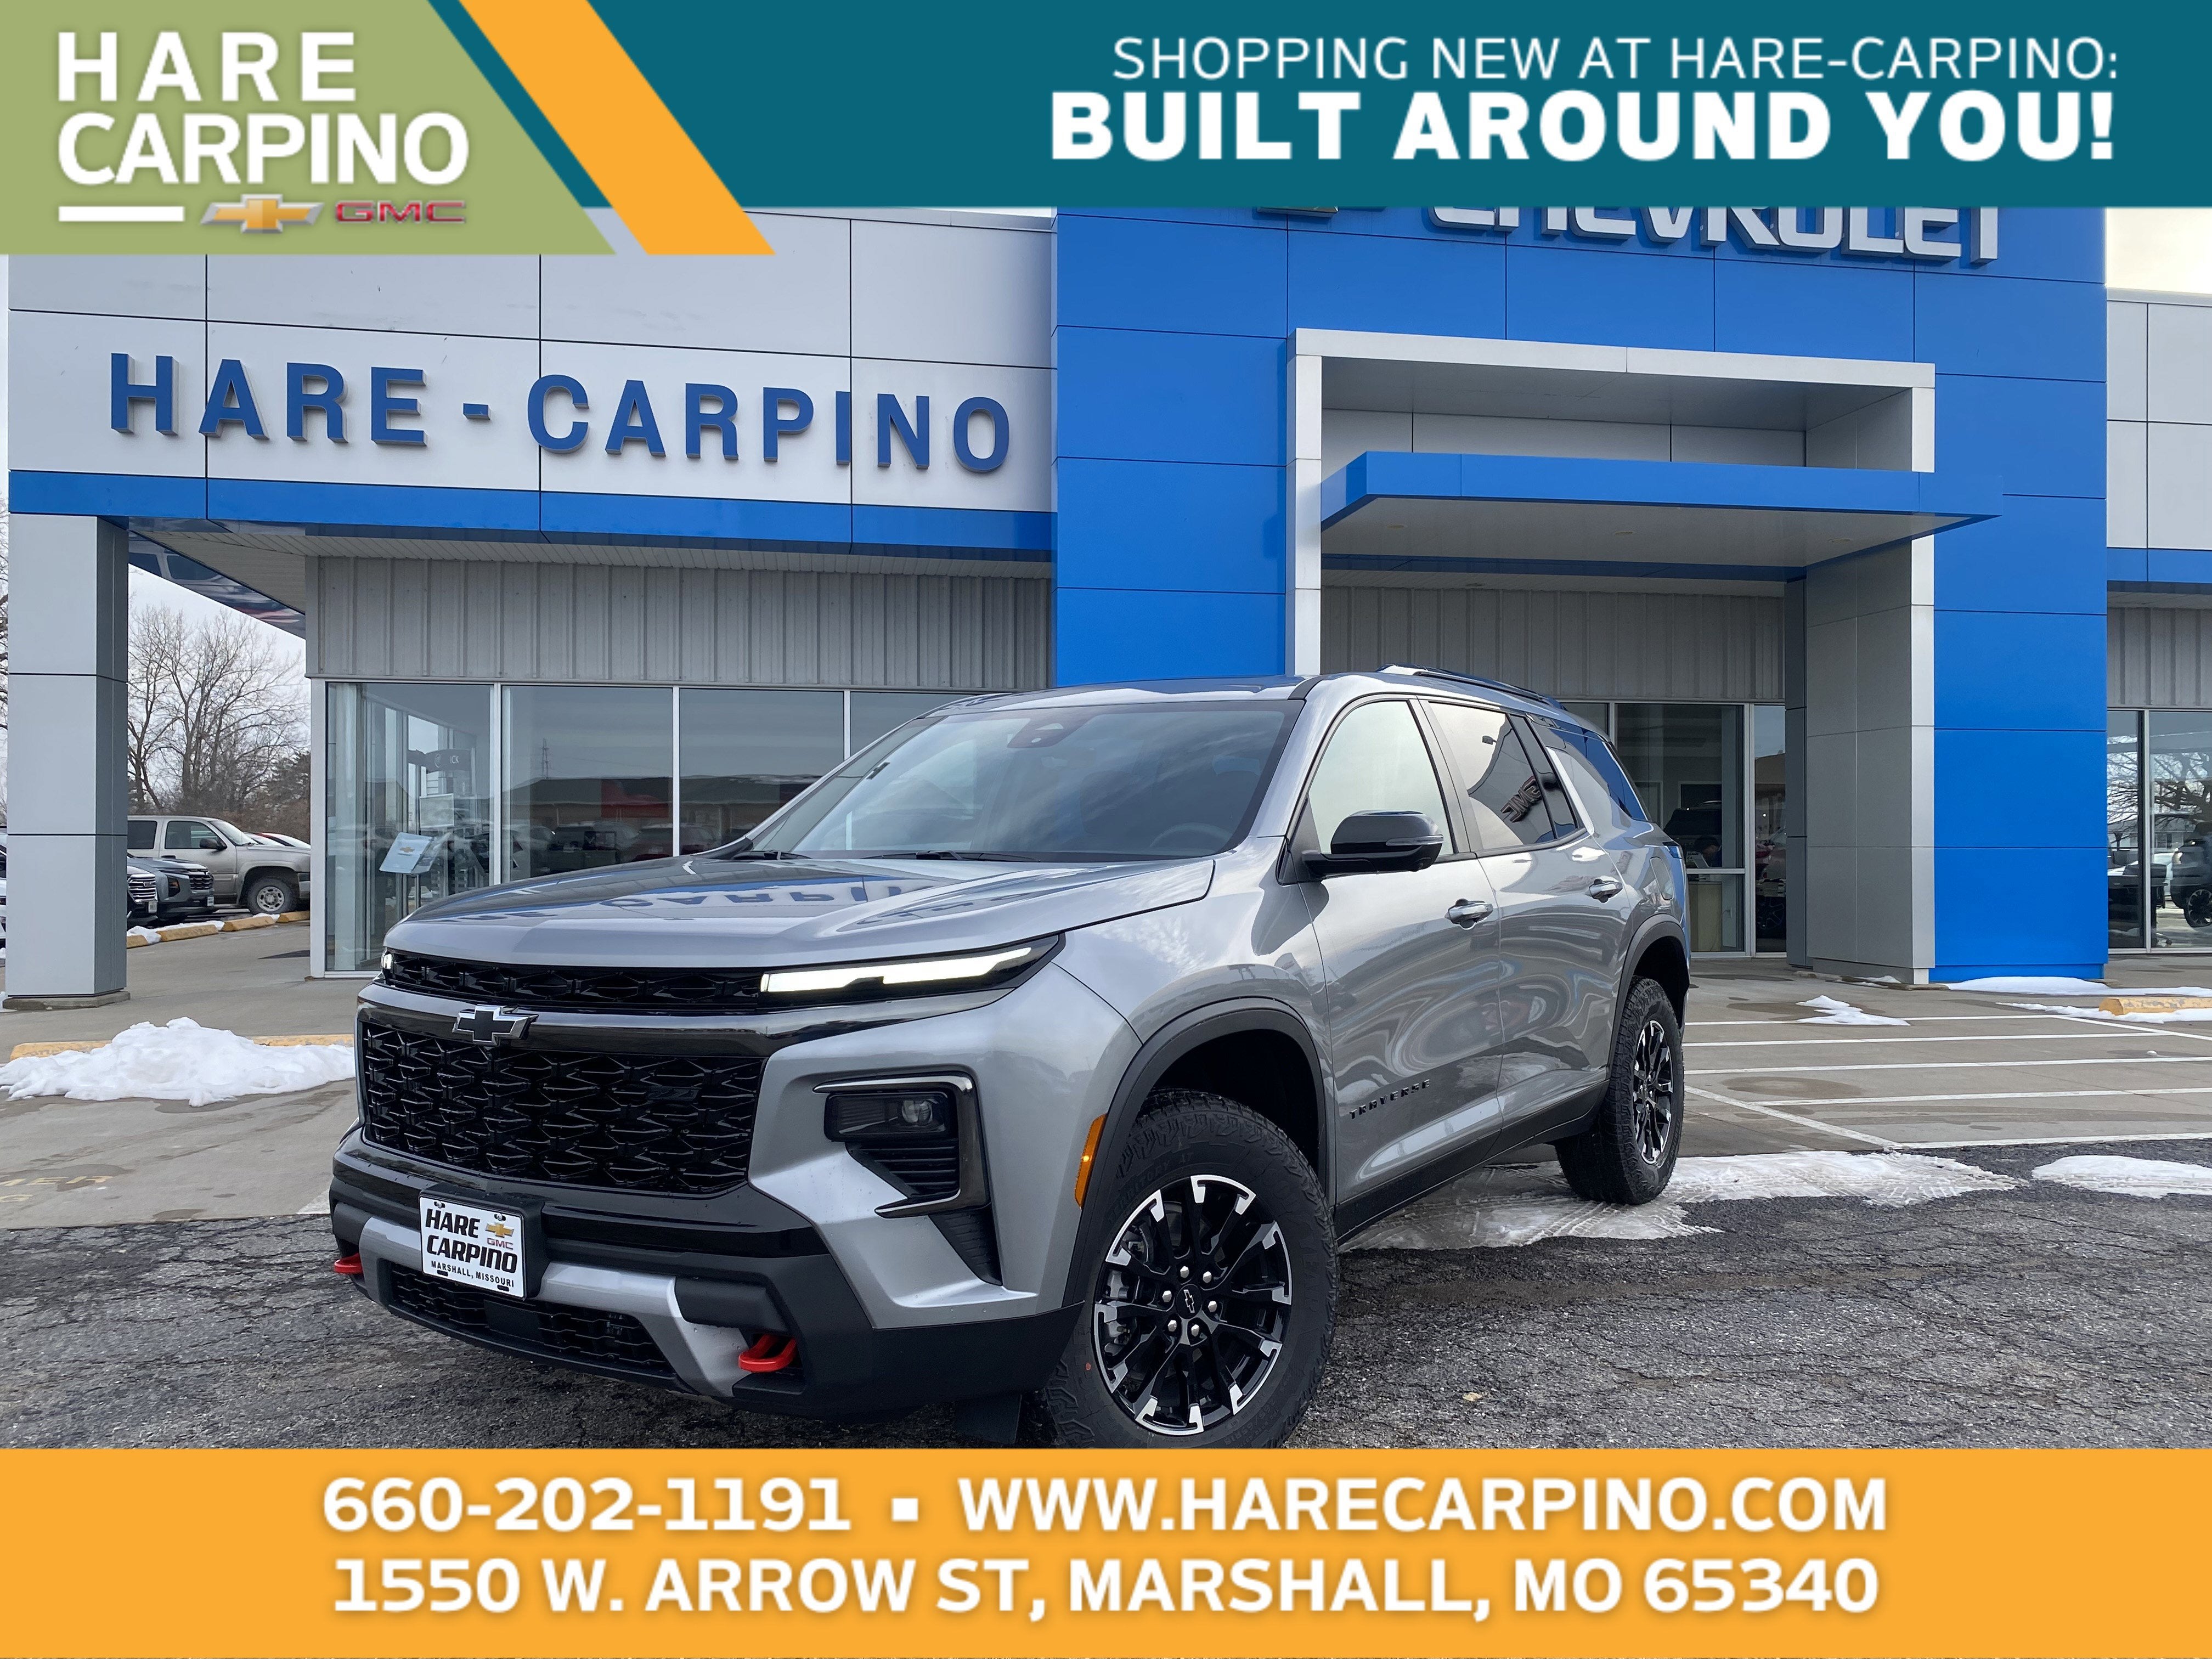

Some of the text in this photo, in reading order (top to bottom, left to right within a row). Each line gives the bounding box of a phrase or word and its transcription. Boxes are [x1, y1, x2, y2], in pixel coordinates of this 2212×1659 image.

[1431, 206, 1998, 264] ROLET
[110, 353, 428, 447] HARE
[527, 374, 1011, 472] CARPINO
[1349, 1079, 1430, 1120] TRAVERSE
[425, 1208, 481, 1239] HARE
[487, 1237, 514, 1250] GMC
[426, 1234, 518, 1274] CARPINO
[431, 1260, 514, 1288] MARSHALL, MISSOURI
